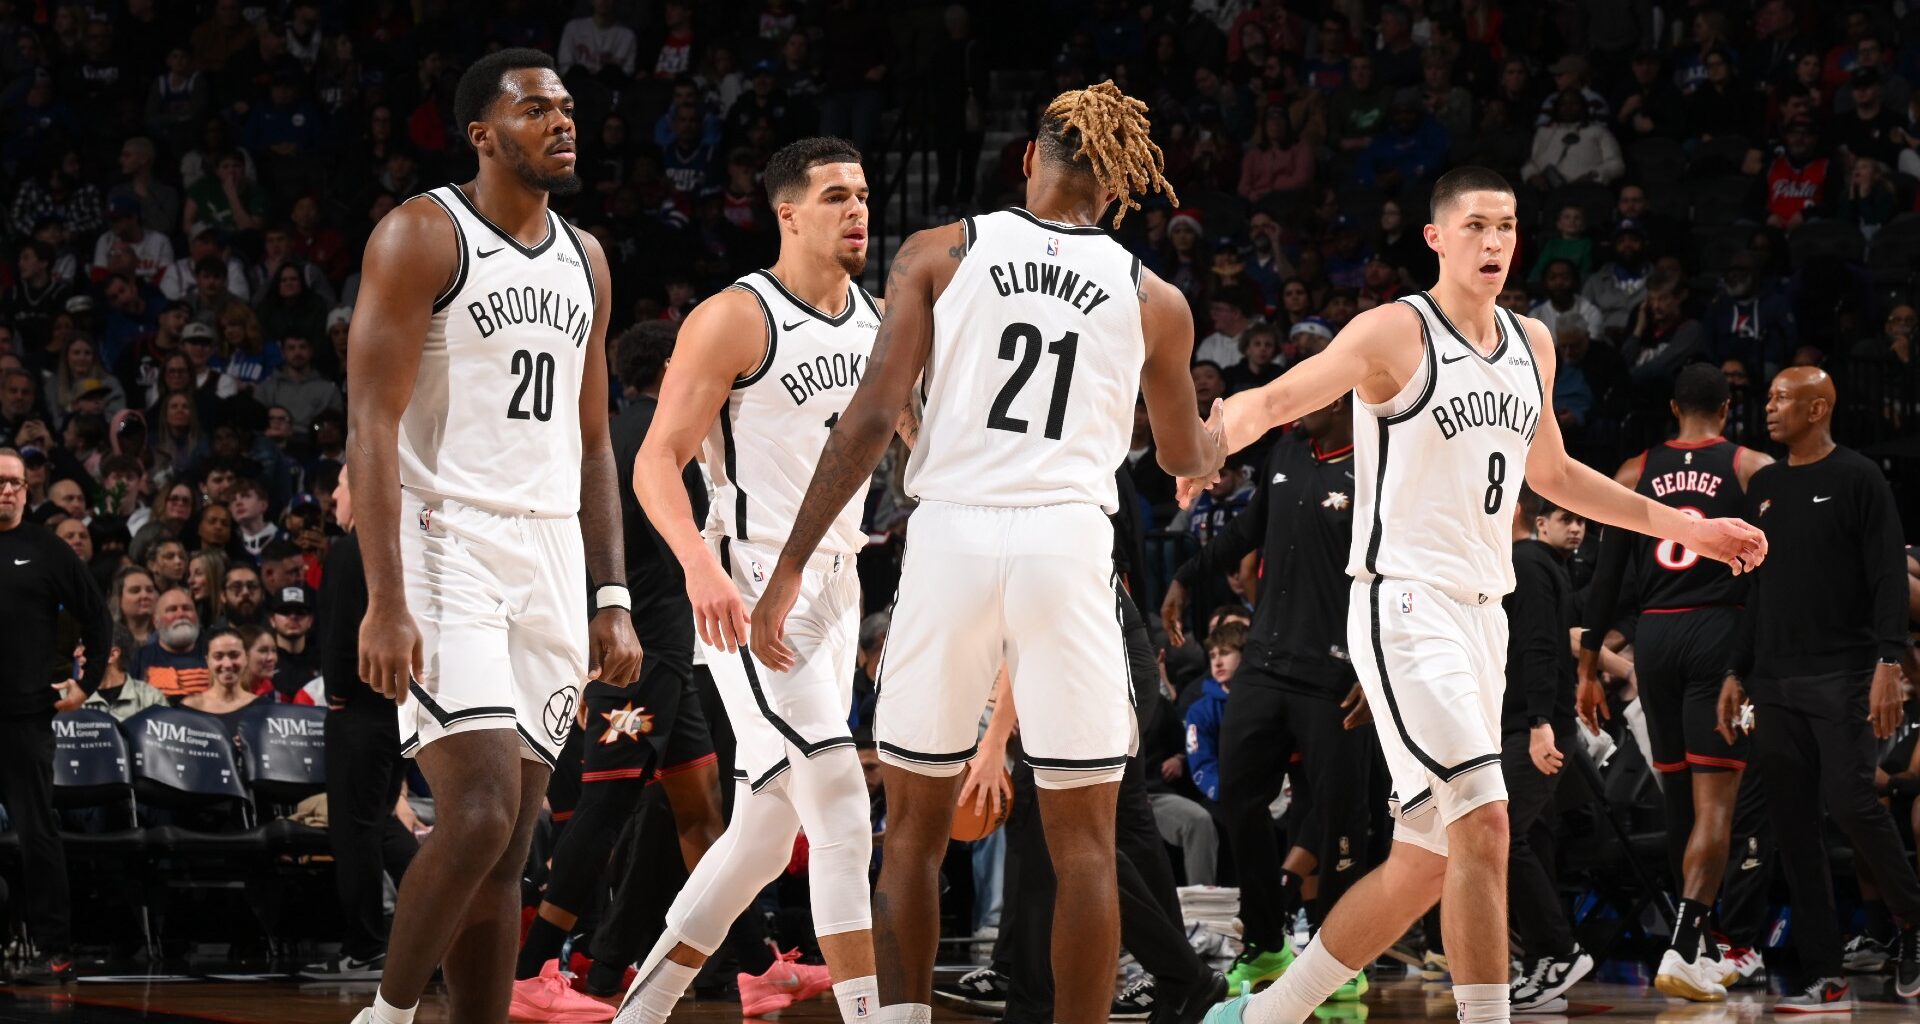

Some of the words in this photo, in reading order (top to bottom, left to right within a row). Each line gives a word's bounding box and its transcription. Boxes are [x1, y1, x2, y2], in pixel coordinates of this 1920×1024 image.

[989, 261, 1110, 316] CLOWNEY
[467, 286, 590, 349] BROOKLYN
[507, 349, 555, 422] 20
[780, 352, 869, 406] BROOK
[986, 322, 1079, 441] 21
[1484, 451, 1506, 515] 8
[1651, 470, 1723, 498] GEORGE
[146, 719, 187, 743] NJM
[266, 717, 307, 738] NJM
